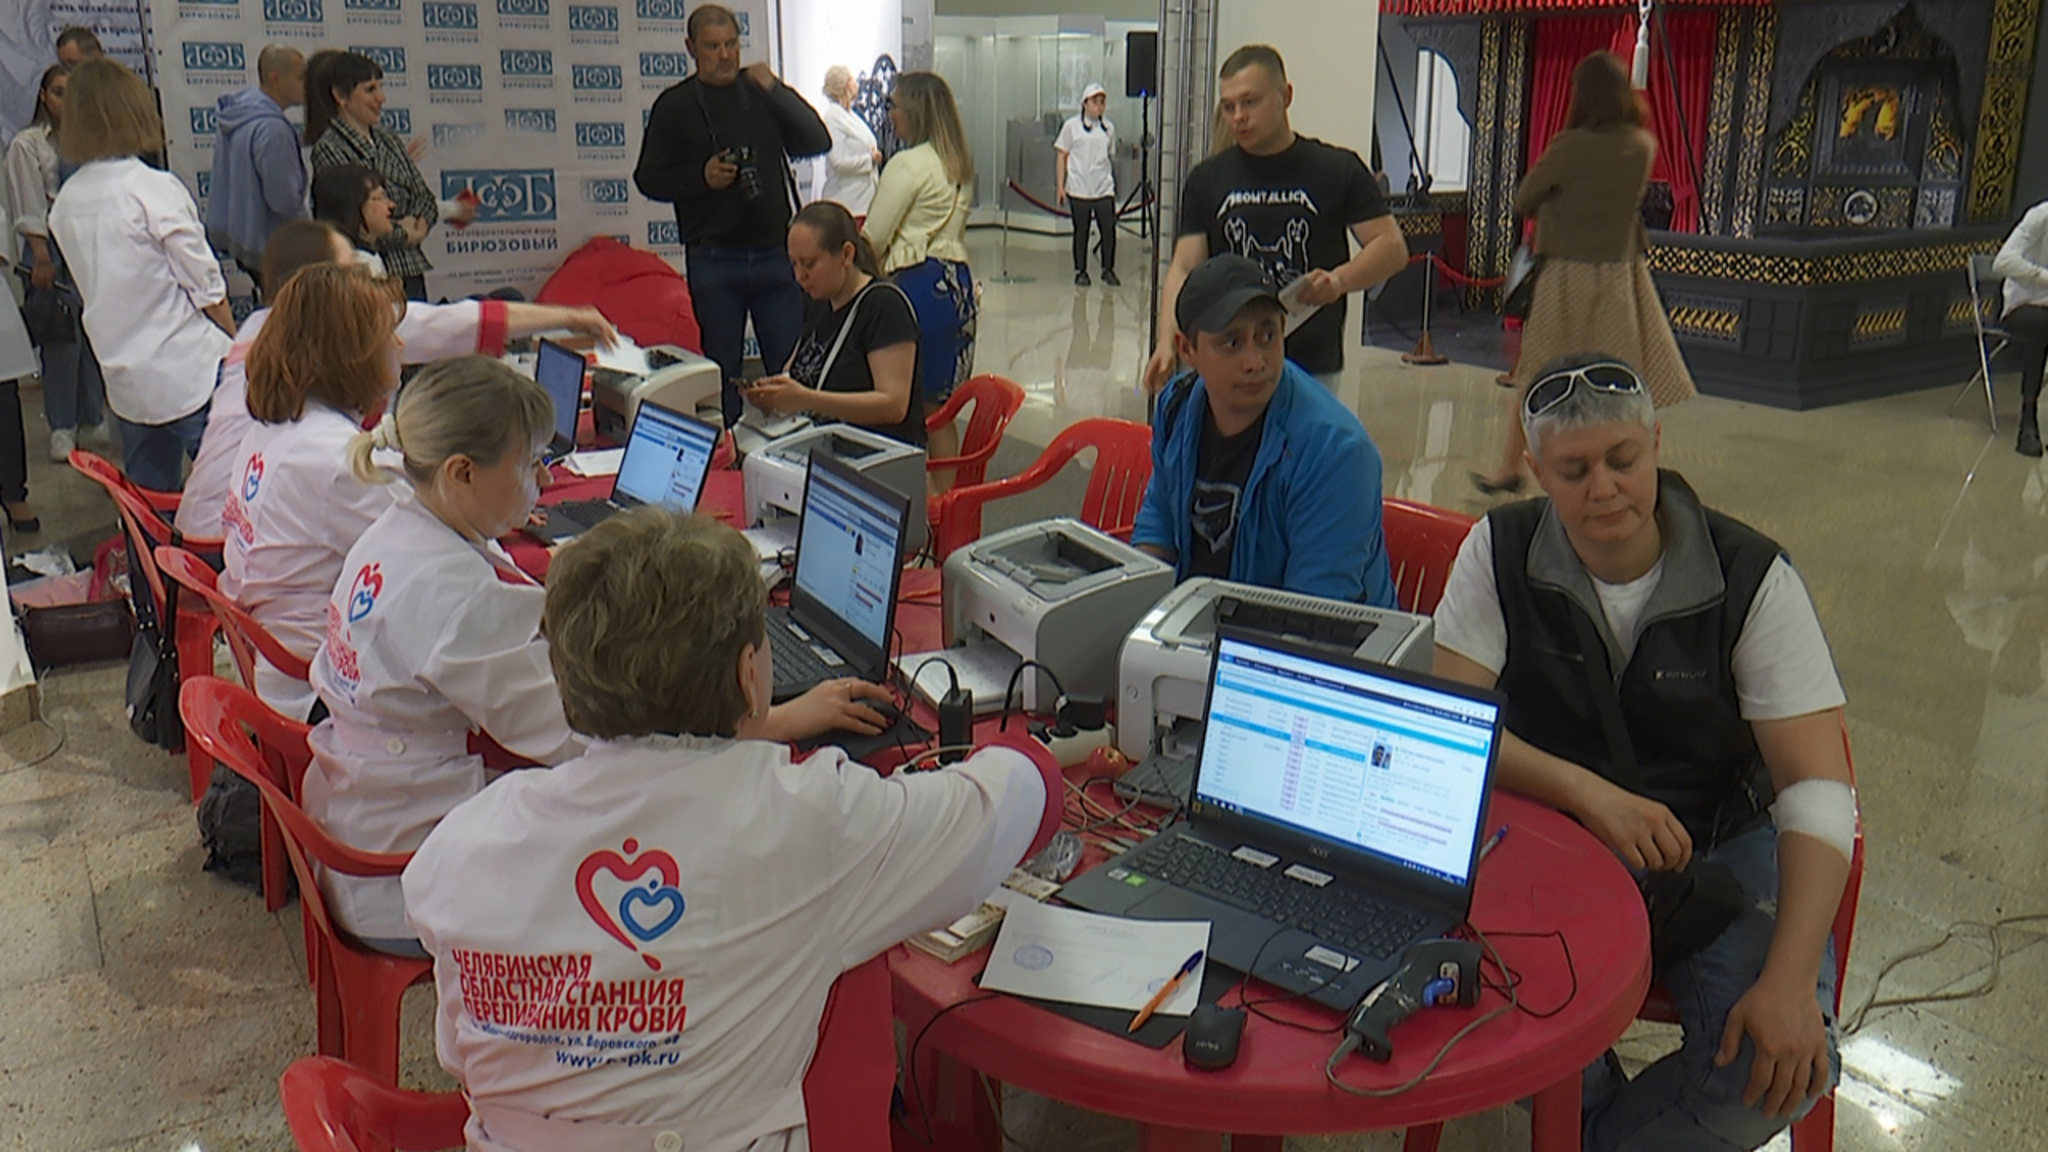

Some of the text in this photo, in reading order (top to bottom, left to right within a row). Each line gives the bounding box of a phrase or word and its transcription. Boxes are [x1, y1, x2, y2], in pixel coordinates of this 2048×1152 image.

[446, 235, 558, 254] БИРЮЗОВЫЙ
[452, 948, 592, 980] ЧЕЛЯБИНСКАЯ
[460, 974, 684, 1009] ОБЛАСТНАЯ СТАНЦИЯ
[597, 1005, 687, 1034] КРОВИ
